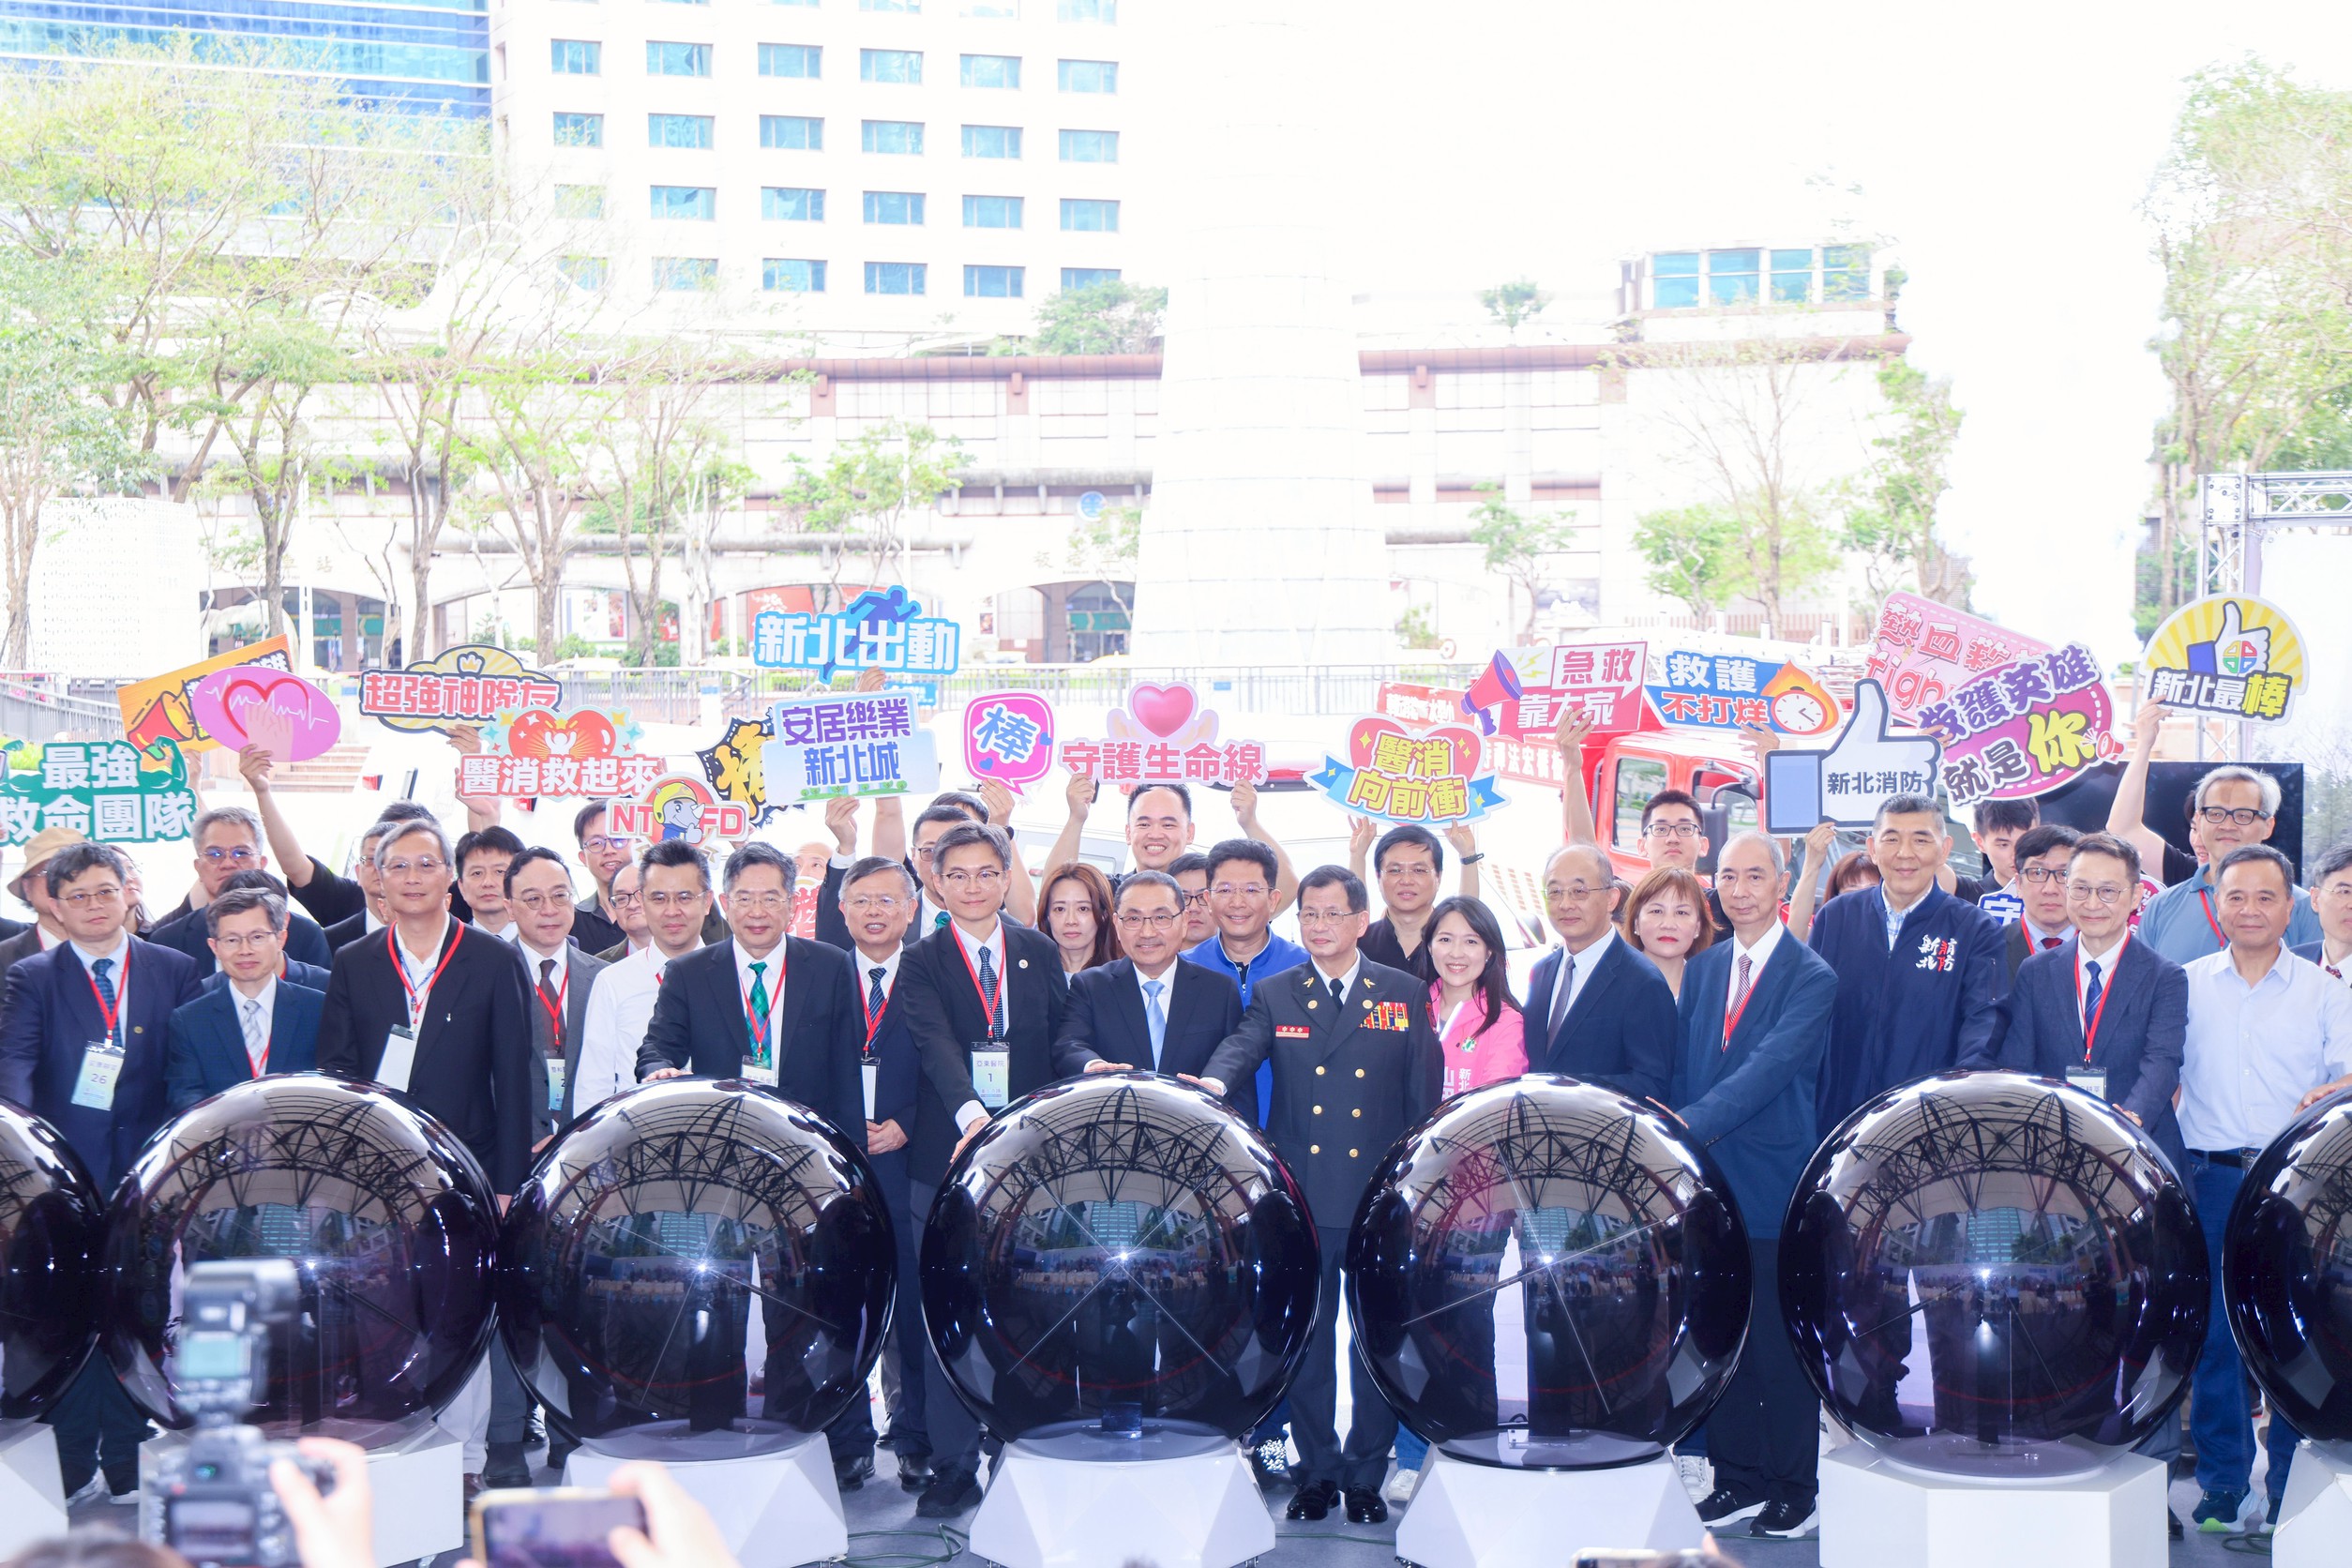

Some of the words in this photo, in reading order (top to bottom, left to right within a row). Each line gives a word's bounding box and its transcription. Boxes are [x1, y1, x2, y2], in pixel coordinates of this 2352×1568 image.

[758, 612, 957, 671] 新北出動
[1878, 601, 2042, 671] 熱血救
[1561, 648, 1636, 685] 急救
[1669, 654, 1757, 693] 救護
[364, 674, 560, 717] 超強神隊友
[1517, 691, 1616, 729] 靠大家
[1662, 692, 1769, 725] 不打烊
[2152, 671, 2288, 716] 新北最棒
[781, 698, 912, 746] 安居樂業
[976, 703, 1041, 765] 棒
[42, 746, 140, 790] 最強
[805, 745, 900, 786] 新北城
[1063, 742, 1262, 781] 守護生命線
[1375, 732, 1451, 776] 醫消
[1943, 710, 2096, 801] 就是你
[463, 757, 659, 795] 醫消救起來
[1348, 769, 1468, 819] 向前衝
[1828, 771, 1922, 794] 新北消防
[0, 792, 193, 842] 救命團隊
[91, 1073, 108, 1084] 26
